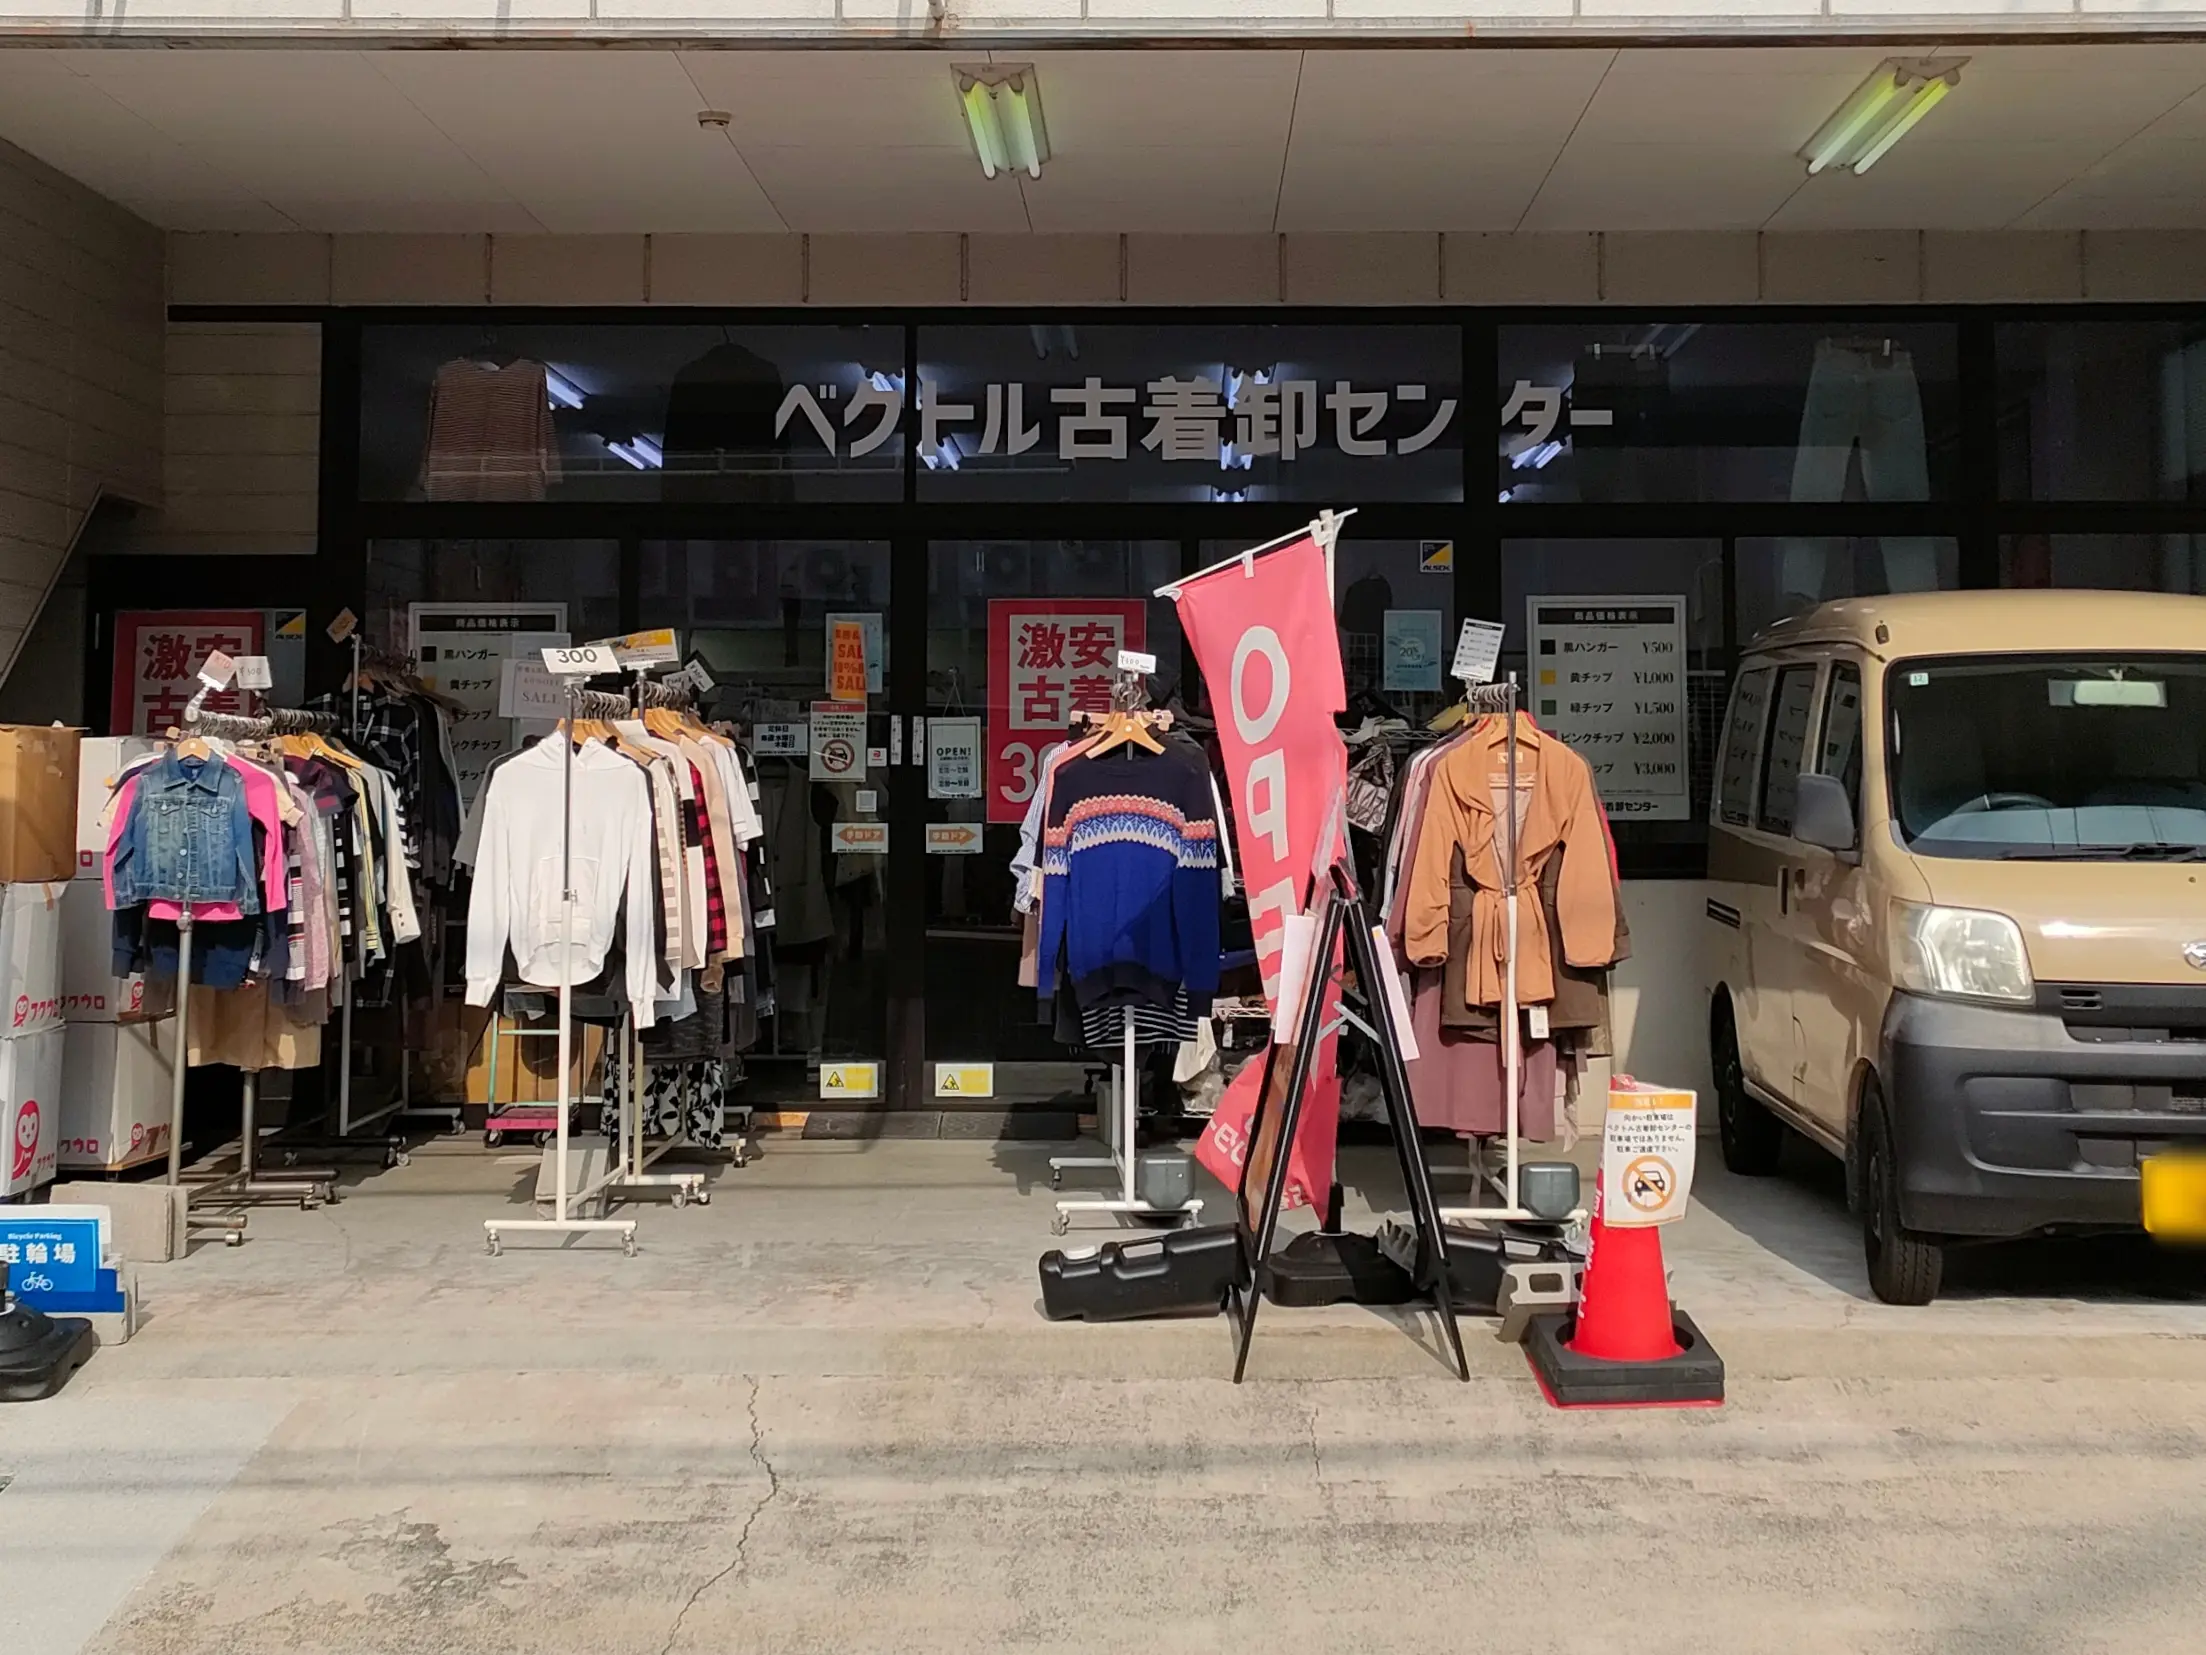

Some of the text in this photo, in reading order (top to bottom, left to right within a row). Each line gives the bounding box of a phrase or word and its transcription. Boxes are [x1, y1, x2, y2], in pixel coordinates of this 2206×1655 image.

[773, 376, 1615, 463] ベクトル古着卸センター
[1017, 622, 1117, 669] 激安
[1563, 640, 1673, 654] 黒ハンガー ¥500
[556, 648, 598, 664] 300
[1633, 671, 1674, 685] ¥1,000
[1634, 701, 1675, 715] ¥1,500
[1632, 731, 1675, 745] ¥2,000
[936, 747, 971, 757] OPEN!
[1634, 762, 1676, 776] ¥3,000
